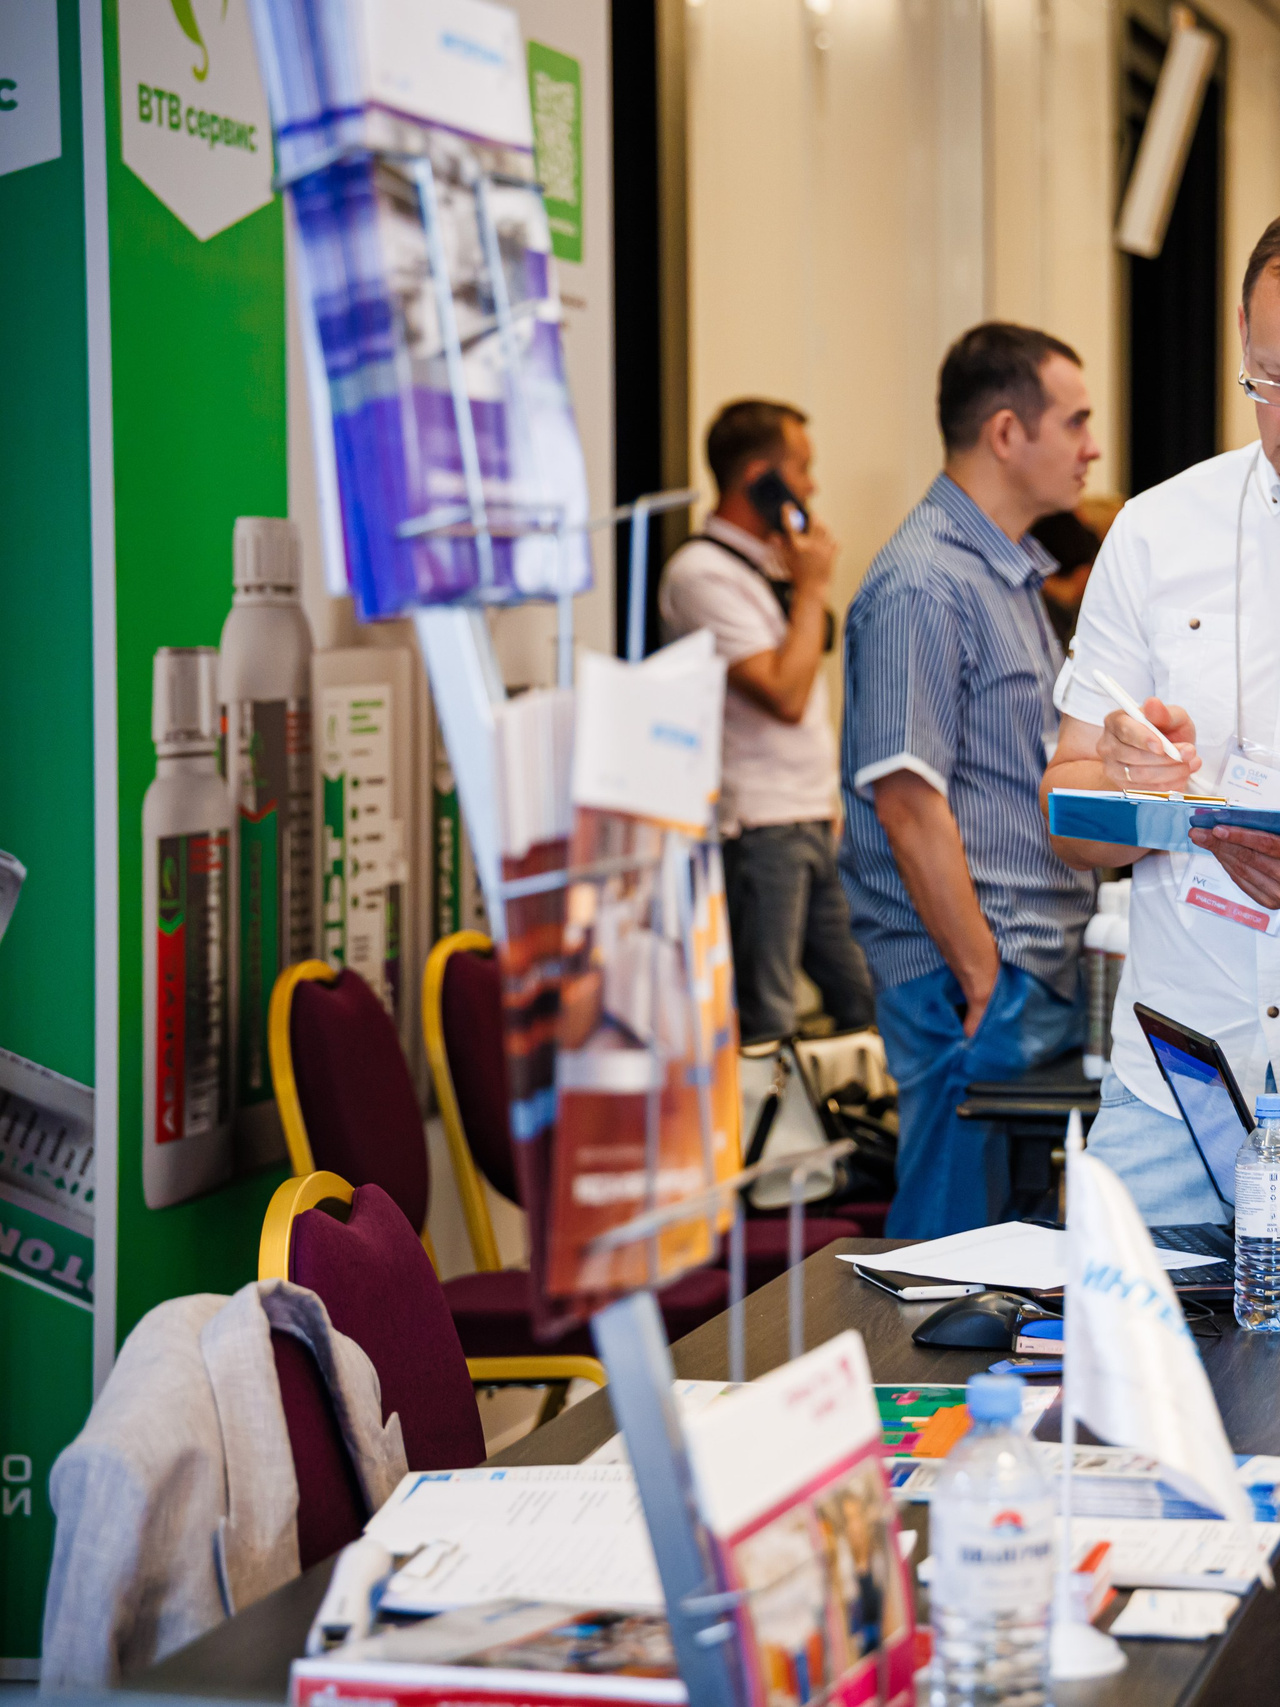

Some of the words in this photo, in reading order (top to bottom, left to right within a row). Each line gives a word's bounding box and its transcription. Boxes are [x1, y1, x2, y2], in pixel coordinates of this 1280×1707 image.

[138, 83, 182, 131] ВТВ
[186, 106, 258, 152] сервис
[1248, 769, 1268, 780] CLEAN
